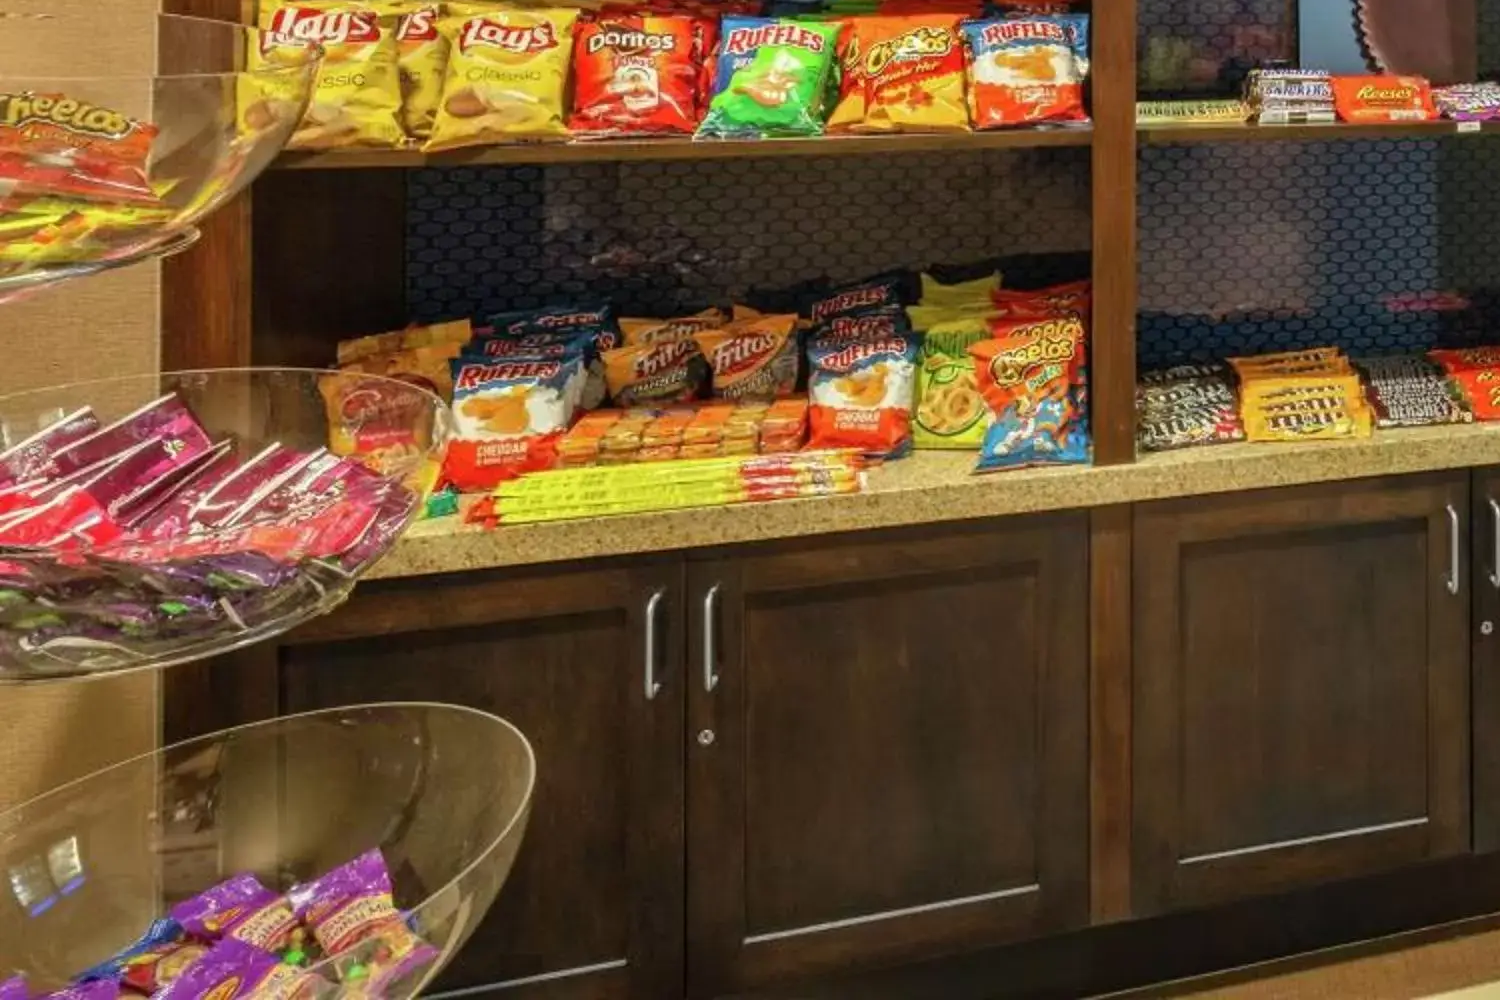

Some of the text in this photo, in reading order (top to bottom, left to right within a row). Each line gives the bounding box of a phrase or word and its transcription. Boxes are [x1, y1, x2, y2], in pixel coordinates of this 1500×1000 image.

[589, 30, 673, 53] Doritos
[727, 24, 824, 55] RUFFLES
[982, 21, 1064, 45] RUFFLES
[712, 330, 776, 374] Fritos
[456, 362, 561, 389] RUFFLES
